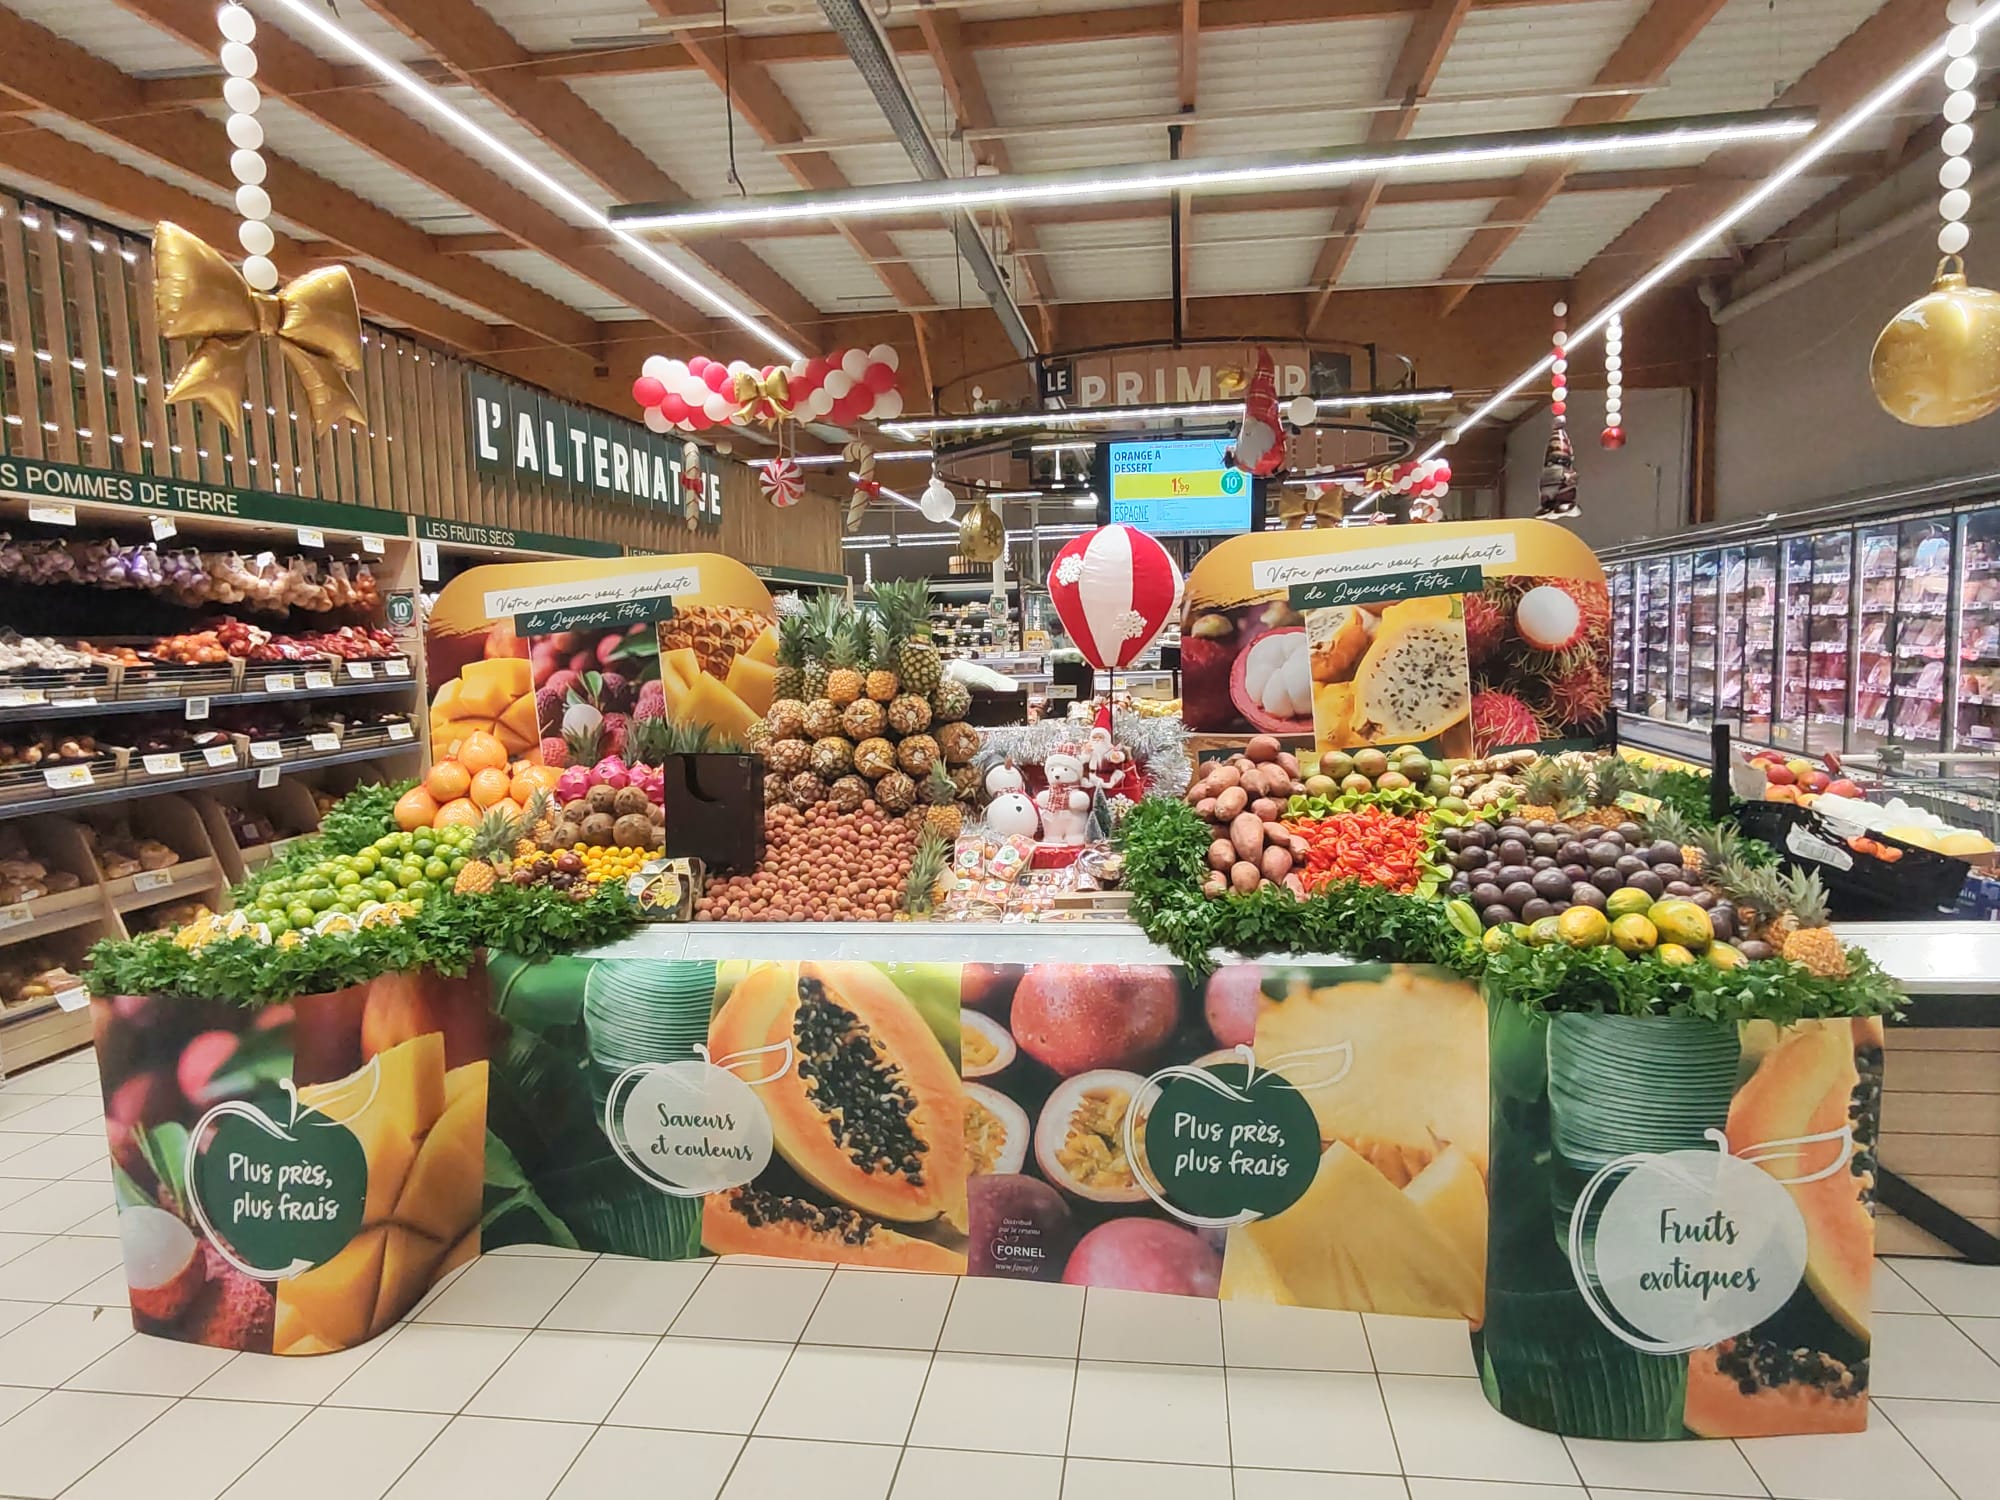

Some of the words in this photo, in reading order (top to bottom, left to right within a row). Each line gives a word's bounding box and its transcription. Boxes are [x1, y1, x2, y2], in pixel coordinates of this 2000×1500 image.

[1047, 370, 1067, 391] LE
[1114, 450, 1152, 461] ORANGE
[1114, 463, 1153, 473] DESSERT
[26, 467, 134, 501] POMMES
[140, 482, 169, 506] DE
[173, 487, 239, 514] TERRE
[1114, 505, 1150, 521] ESPAGNE
[426, 521, 448, 539] LES
[450, 525, 487, 544] FRUITS
[489, 530, 515, 546] SECS
[1267, 565, 1311, 583] Votre
[1313, 560, 1383, 581] primeur
[1387, 555, 1424, 570] vous
[1430, 543, 1506, 568] souhaite
[496, 597, 532, 612] Votre
[534, 592, 591, 611] primeur
[594, 587, 624, 600] vous
[630, 575, 692, 597] souhaite
[1304, 585, 1327, 601] de
[1333, 581, 1407, 603] Joyeuses
[1412, 572, 1454, 592] Fêtes
[527, 613, 545, 629] de
[551, 610, 611, 631] Joyeuses
[616, 601, 650, 620] Fêtes
[657, 1102, 736, 1131] Saveurs
[1174, 1111, 1224, 1142] Plus
[1229, 1119, 1286, 1149] près,
[650, 1134, 669, 1155] et
[674, 1136, 754, 1161] couleurs
[1174, 1148, 1223, 1177] plus
[1228, 1149, 1290, 1177] frais
[228, 1152, 273, 1184] Plus
[278, 1159, 333, 1192] près,
[233, 1191, 273, 1224] plus
[278, 1193, 340, 1221] frais
[1660, 1207, 1740, 1245] Fruits
[996, 1245, 1046, 1258] FORNEL
[1640, 1256, 1760, 1301] exotiques
